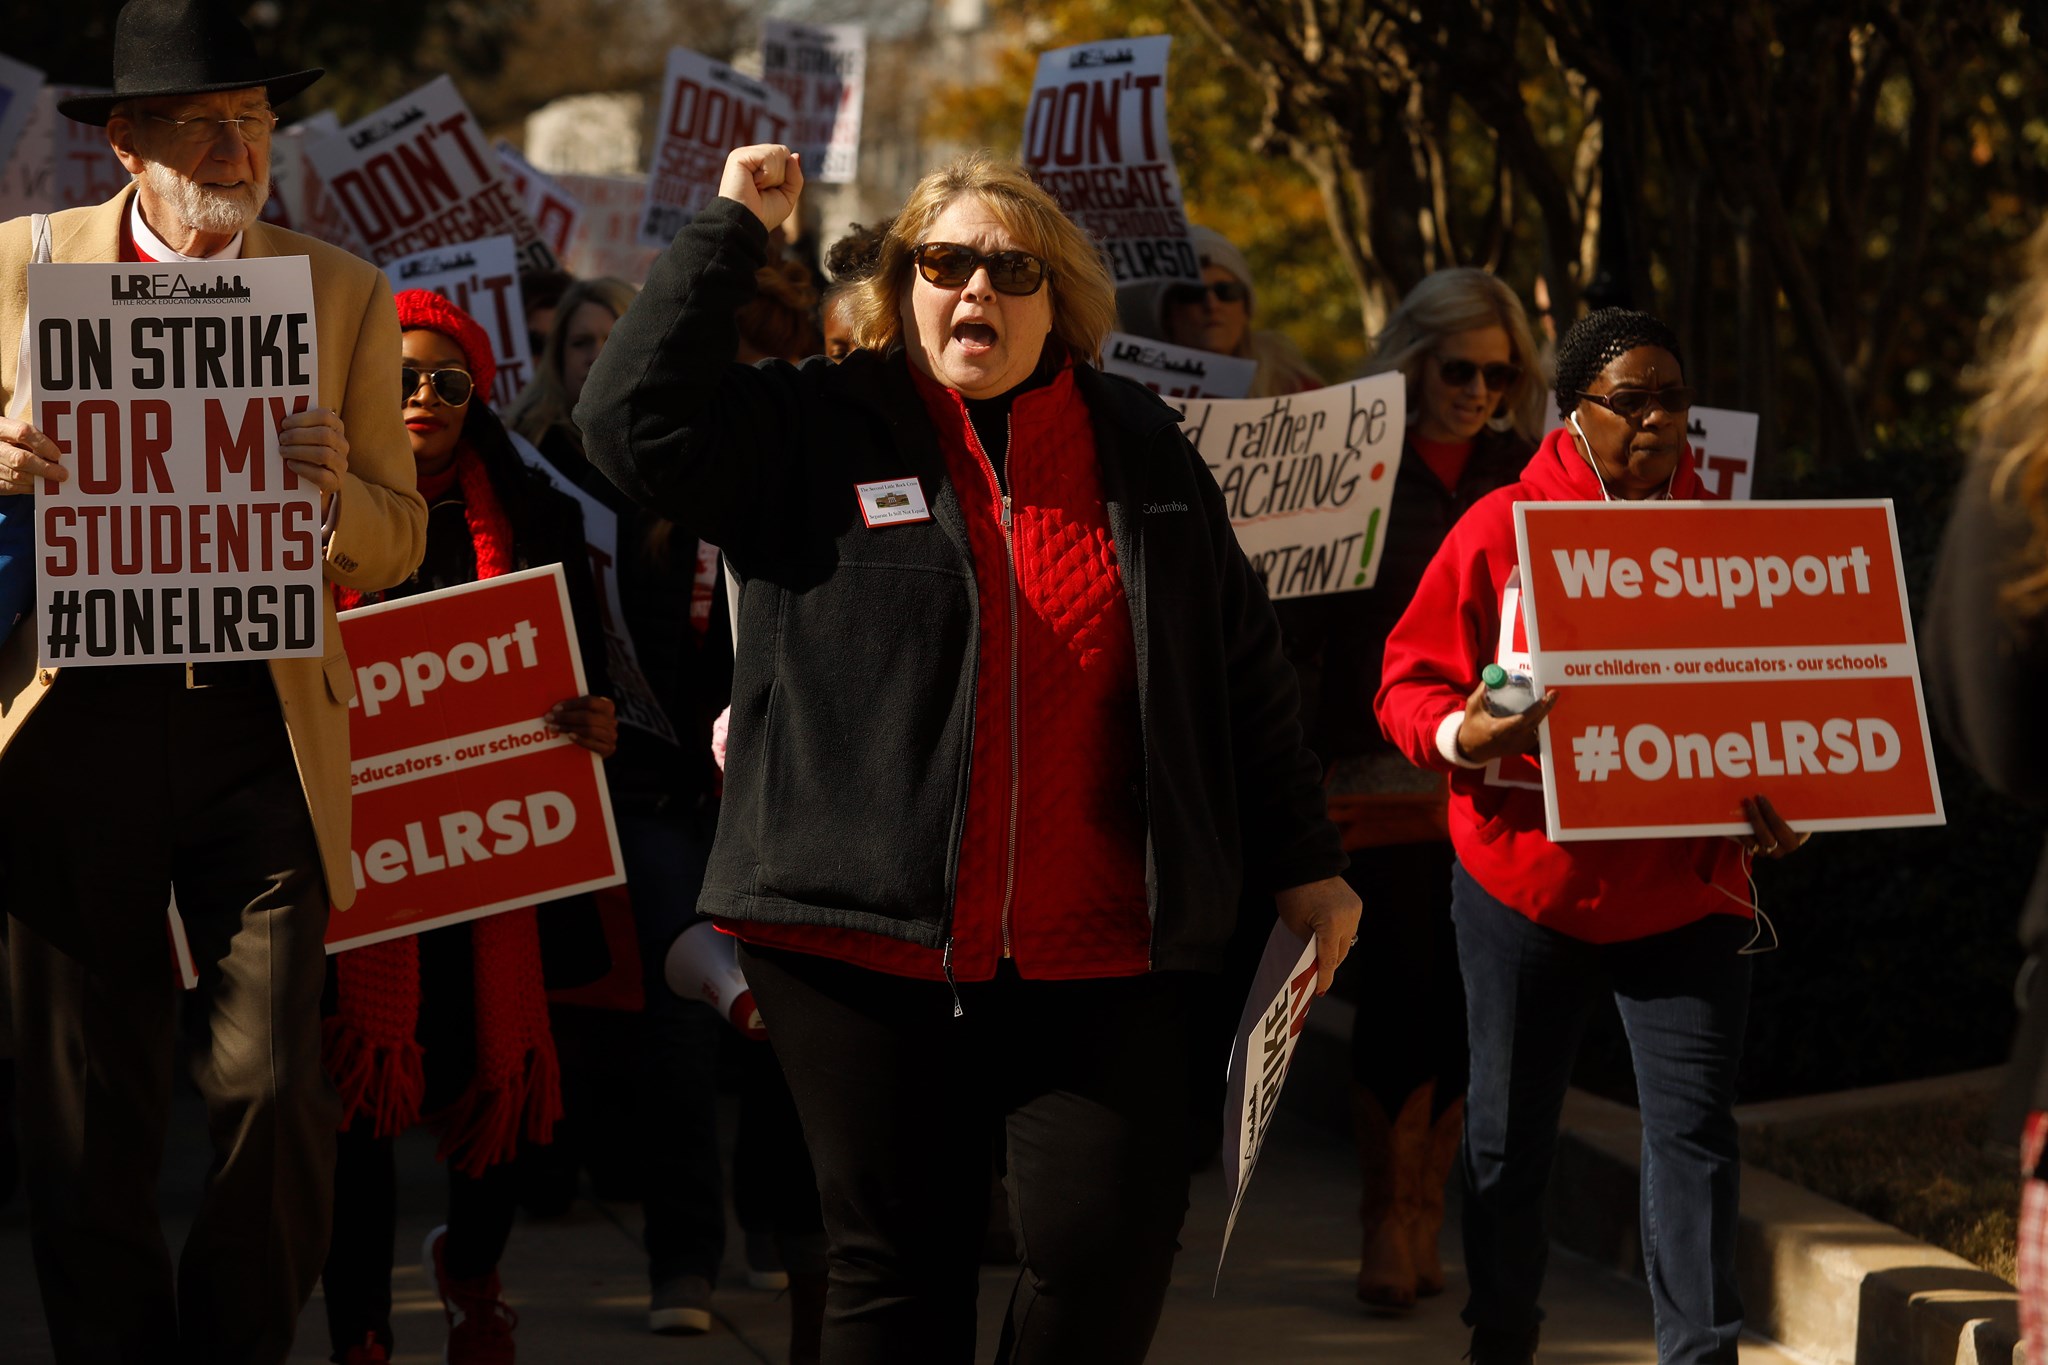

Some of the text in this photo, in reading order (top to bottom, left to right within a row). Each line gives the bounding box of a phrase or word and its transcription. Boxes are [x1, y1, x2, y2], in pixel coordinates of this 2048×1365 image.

[669, 76, 789, 149] DON'T
[1026, 72, 1162, 167] DON'T
[330, 111, 468, 245] DON'T
[111, 274, 191, 300] LREA
[38, 313, 310, 391] ON STRIKE
[41, 399, 175, 495] FOR
[1226, 397, 1327, 460] rather
[1345, 384, 1387, 451] be
[1142, 500, 1189, 515] Columbia
[1210, 450, 1362, 519] ACHING
[44, 501, 314, 577] STUDENTS
[1552, 545, 1871, 609] We Support
[47, 584, 315, 659] #ONELRSD
[1564, 659, 1662, 677] our children
[1674, 657, 1786, 675] our educators
[1796, 654, 1888, 672] our schools
[351, 755, 442, 787] educators
[455, 727, 560, 762] our schools
[1573, 716, 1902, 782] #OneLRSD
